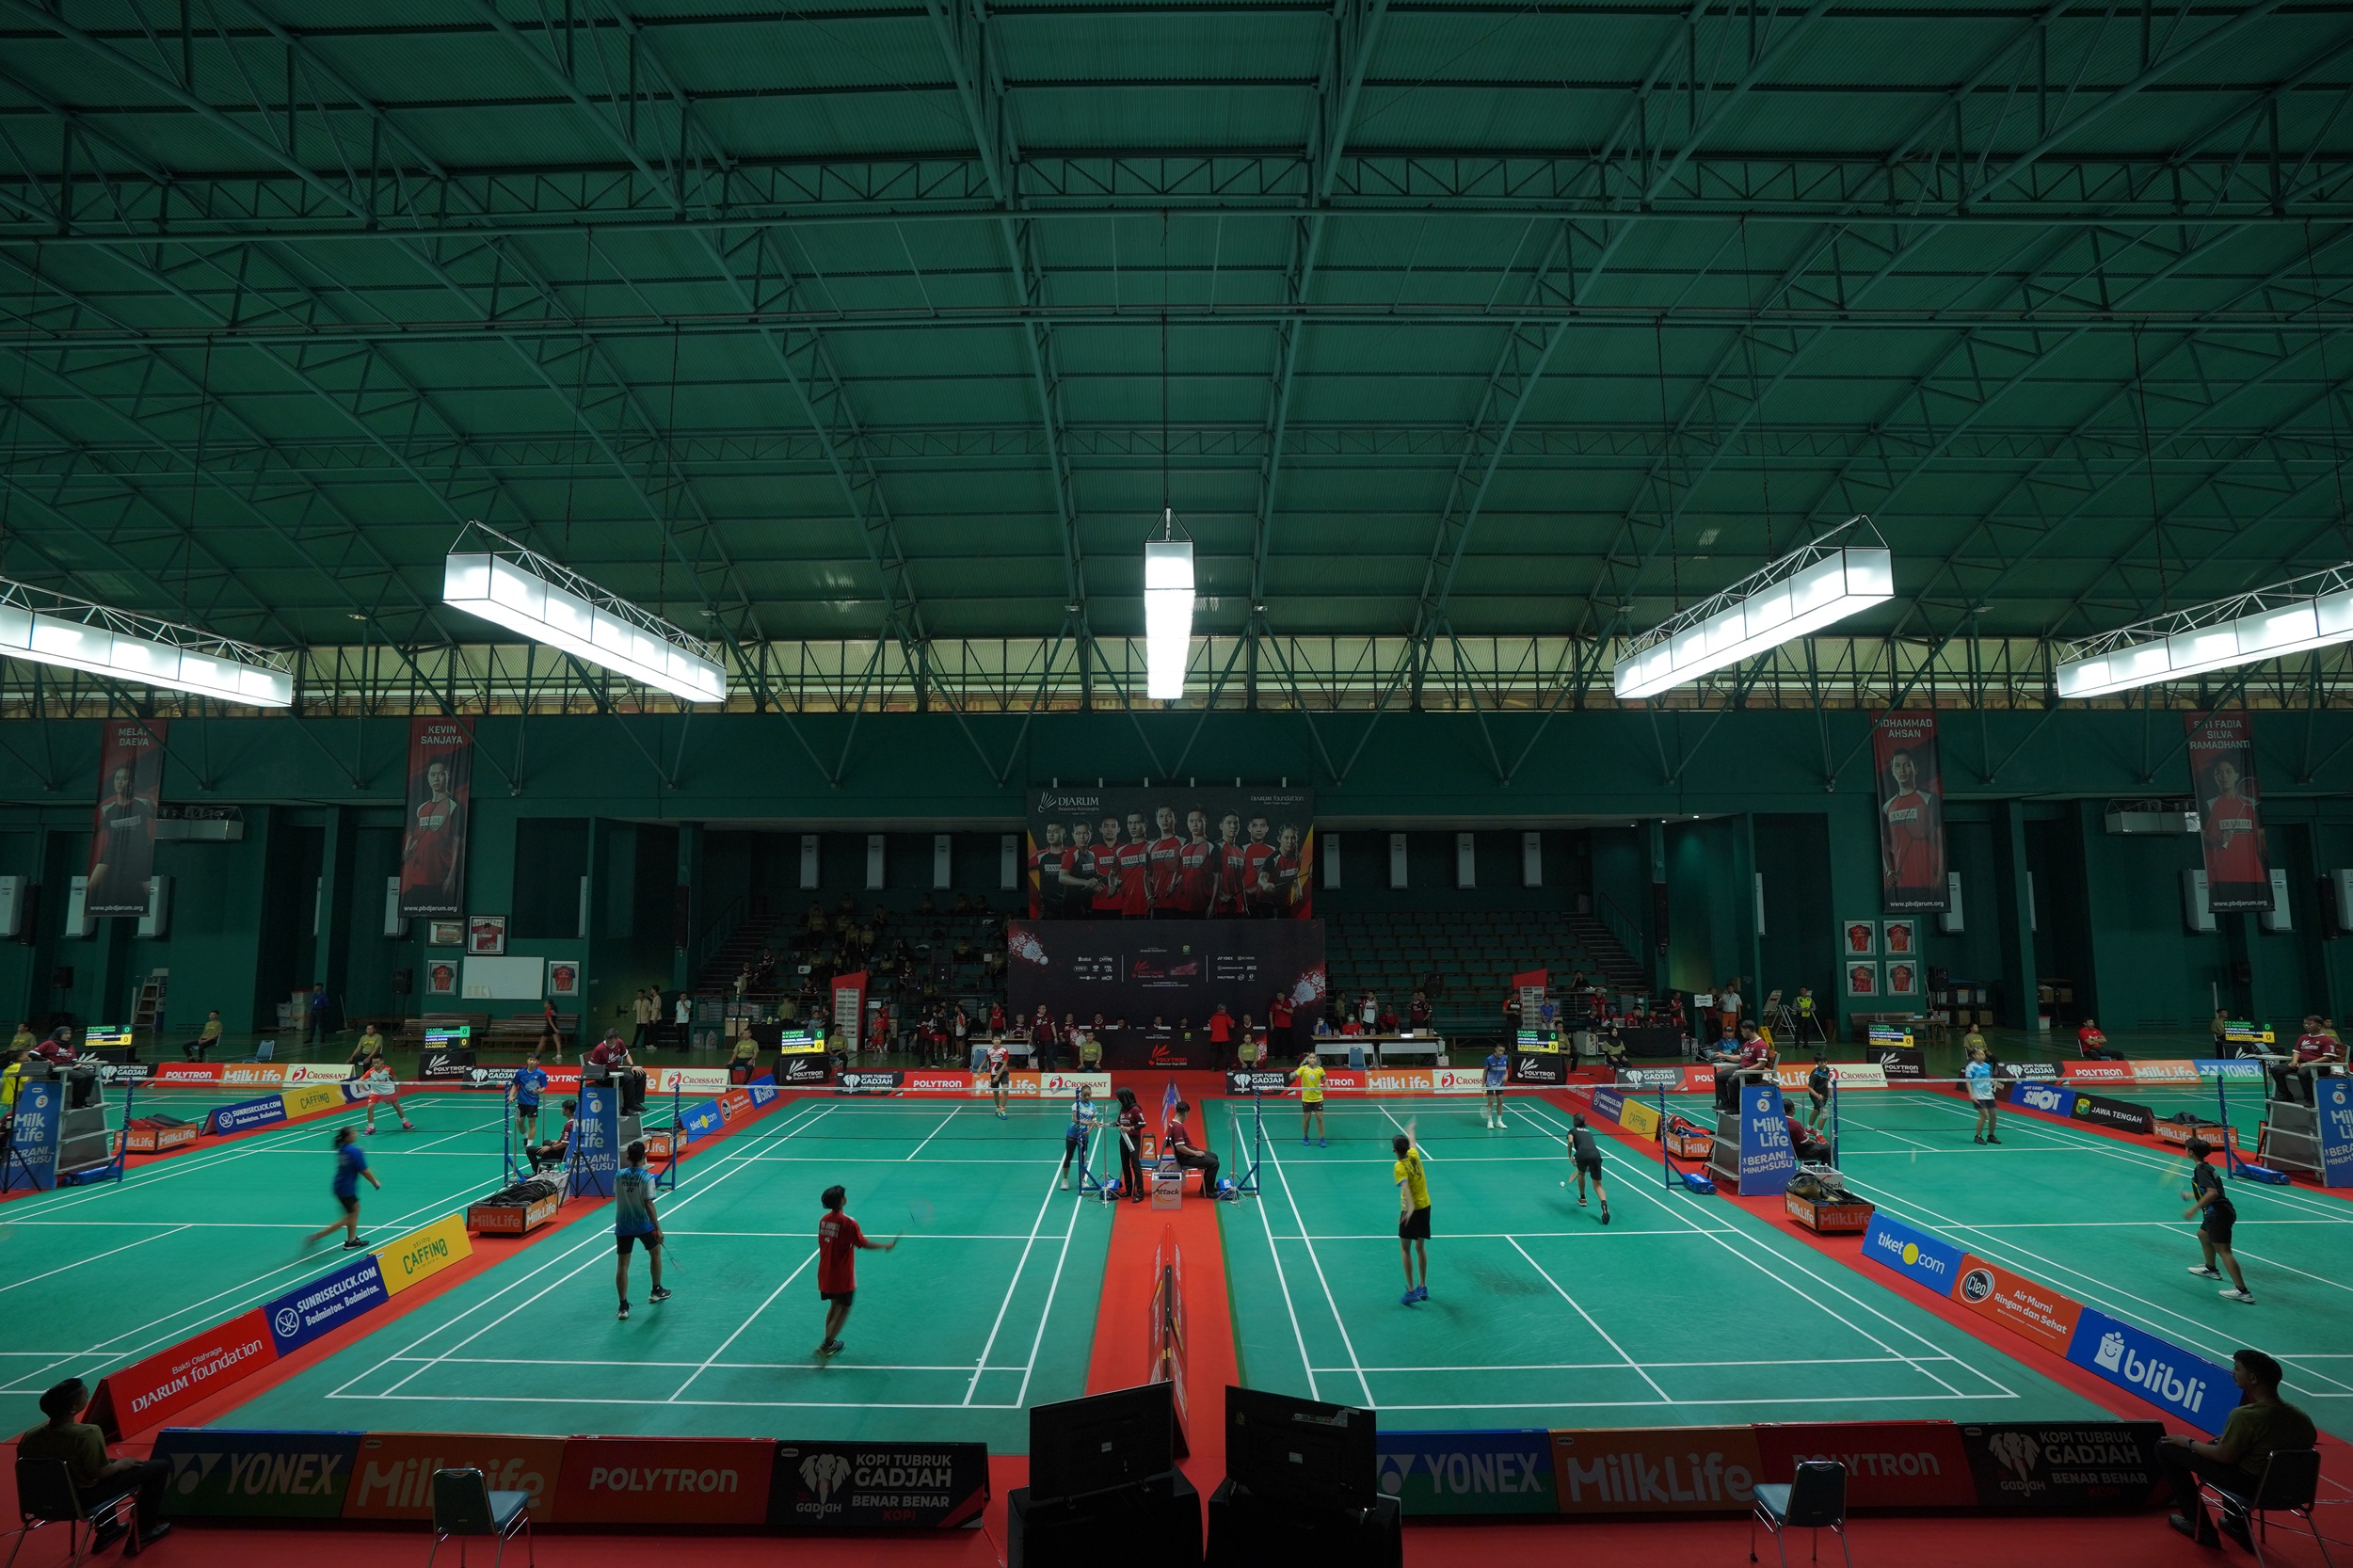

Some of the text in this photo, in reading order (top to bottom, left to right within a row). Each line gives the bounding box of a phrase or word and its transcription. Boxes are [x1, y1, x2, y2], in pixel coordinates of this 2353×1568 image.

[427, 726, 456, 734] KEVIN
[2194, 720, 2242, 728] STI FADIA
[119, 728, 152, 737] MELA
[421, 735, 462, 744] SANJAYA
[1888, 728, 1921, 738] AHSAN
[2206, 730, 2233, 739] SILVA
[120, 738, 149, 746] DAEVA
[2190, 740, 2250, 749] RAMADHANTI
[1058, 796, 1099, 807] DJARUM
[404, 904, 457, 913] www.pbdjarum.org
[223, 1069, 281, 1084] MilkLife
[307, 1071, 347, 1080] CROISSANT
[2075, 1068, 2123, 1077] POLYTRON
[2134, 1066, 2196, 1081] MilkLife
[2222, 1064, 2263, 1078] YONEX
[682, 1075, 724, 1084] CROISSANT
[913, 1080, 962, 1088] POLYTRON
[1064, 1080, 1107, 1089] CROISSANT
[1369, 1076, 1431, 1090] MilkLife
[300, 1093, 330, 1109] CAFFINO
[1760, 1101, 1767, 1110] 2
[2336, 1094, 2342, 1102] 4
[13, 1112, 45, 1128] Milk
[2091, 1106, 2143, 1124] JAWA TENGAH
[2331, 1111, 2353, 1125] Mil
[1753, 1116, 1786, 1132] Milk
[15, 1128, 44, 1143] Life
[159, 1129, 196, 1145] MilkLife
[1760, 1132, 1789, 1147] Life
[2198, 1131, 2236, 1144] MilkLfe
[2340, 1126, 2353, 1139] Li
[1144, 1142, 1154, 1155] 2
[2331, 1145, 2353, 1157] BERA
[26, 1155, 52, 1165] SUSU
[590, 1161, 615, 1171] SUSU
[1747, 1151, 1787, 1166] BERANI
[2327, 1155, 2352, 1165] MINUM
[1743, 1160, 1793, 1175] MINUM SUSU
[526, 1204, 556, 1225] MilkLife
[1786, 1199, 1815, 1224] MilkLife
[1820, 1211, 1869, 1226] MilkLife
[472, 1214, 520, 1227] MilkLife
[403, 1238, 449, 1275] CAFFINO
[296, 1266, 377, 1313] SUNRISECLICK.COM
[1966, 1274, 1988, 1296] Cleo
[305, 1285, 380, 1327] Badminton. Badminton.
[2013, 1288, 2054, 1315] Air Murni
[1993, 1291, 2023, 1313] Ringan
[2023, 1306, 2041, 1321] dan
[2040, 1315, 2068, 1335] Sehat
[171, 1346, 223, 1375] Bakti Olahraga
[131, 1338, 264, 1414] DJARUM foundation
[2123, 1349, 2207, 1414] blibli
[2039, 1430, 2134, 1444] KOPI TUBRUK
[856, 1453, 952, 1468] KOPI TUBRUK
[2044, 1445, 2142, 1464] GADJAH
[1792, 1452, 1941, 1477] YTRON
[228, 1452, 343, 1496] YONEX
[589, 1466, 739, 1493] POLYTRON
[854, 1467, 952, 1489] GADJAH
[1424, 1452, 1544, 1495] YONEX
[1567, 1452, 1757, 1504] MilkLife
[2052, 1471, 2149, 1485] BENAR BENAR
[357, 1458, 544, 1508] Milife
[852, 1494, 951, 1509] BENAR BENAR
[883, 1509, 916, 1522] KOPI
